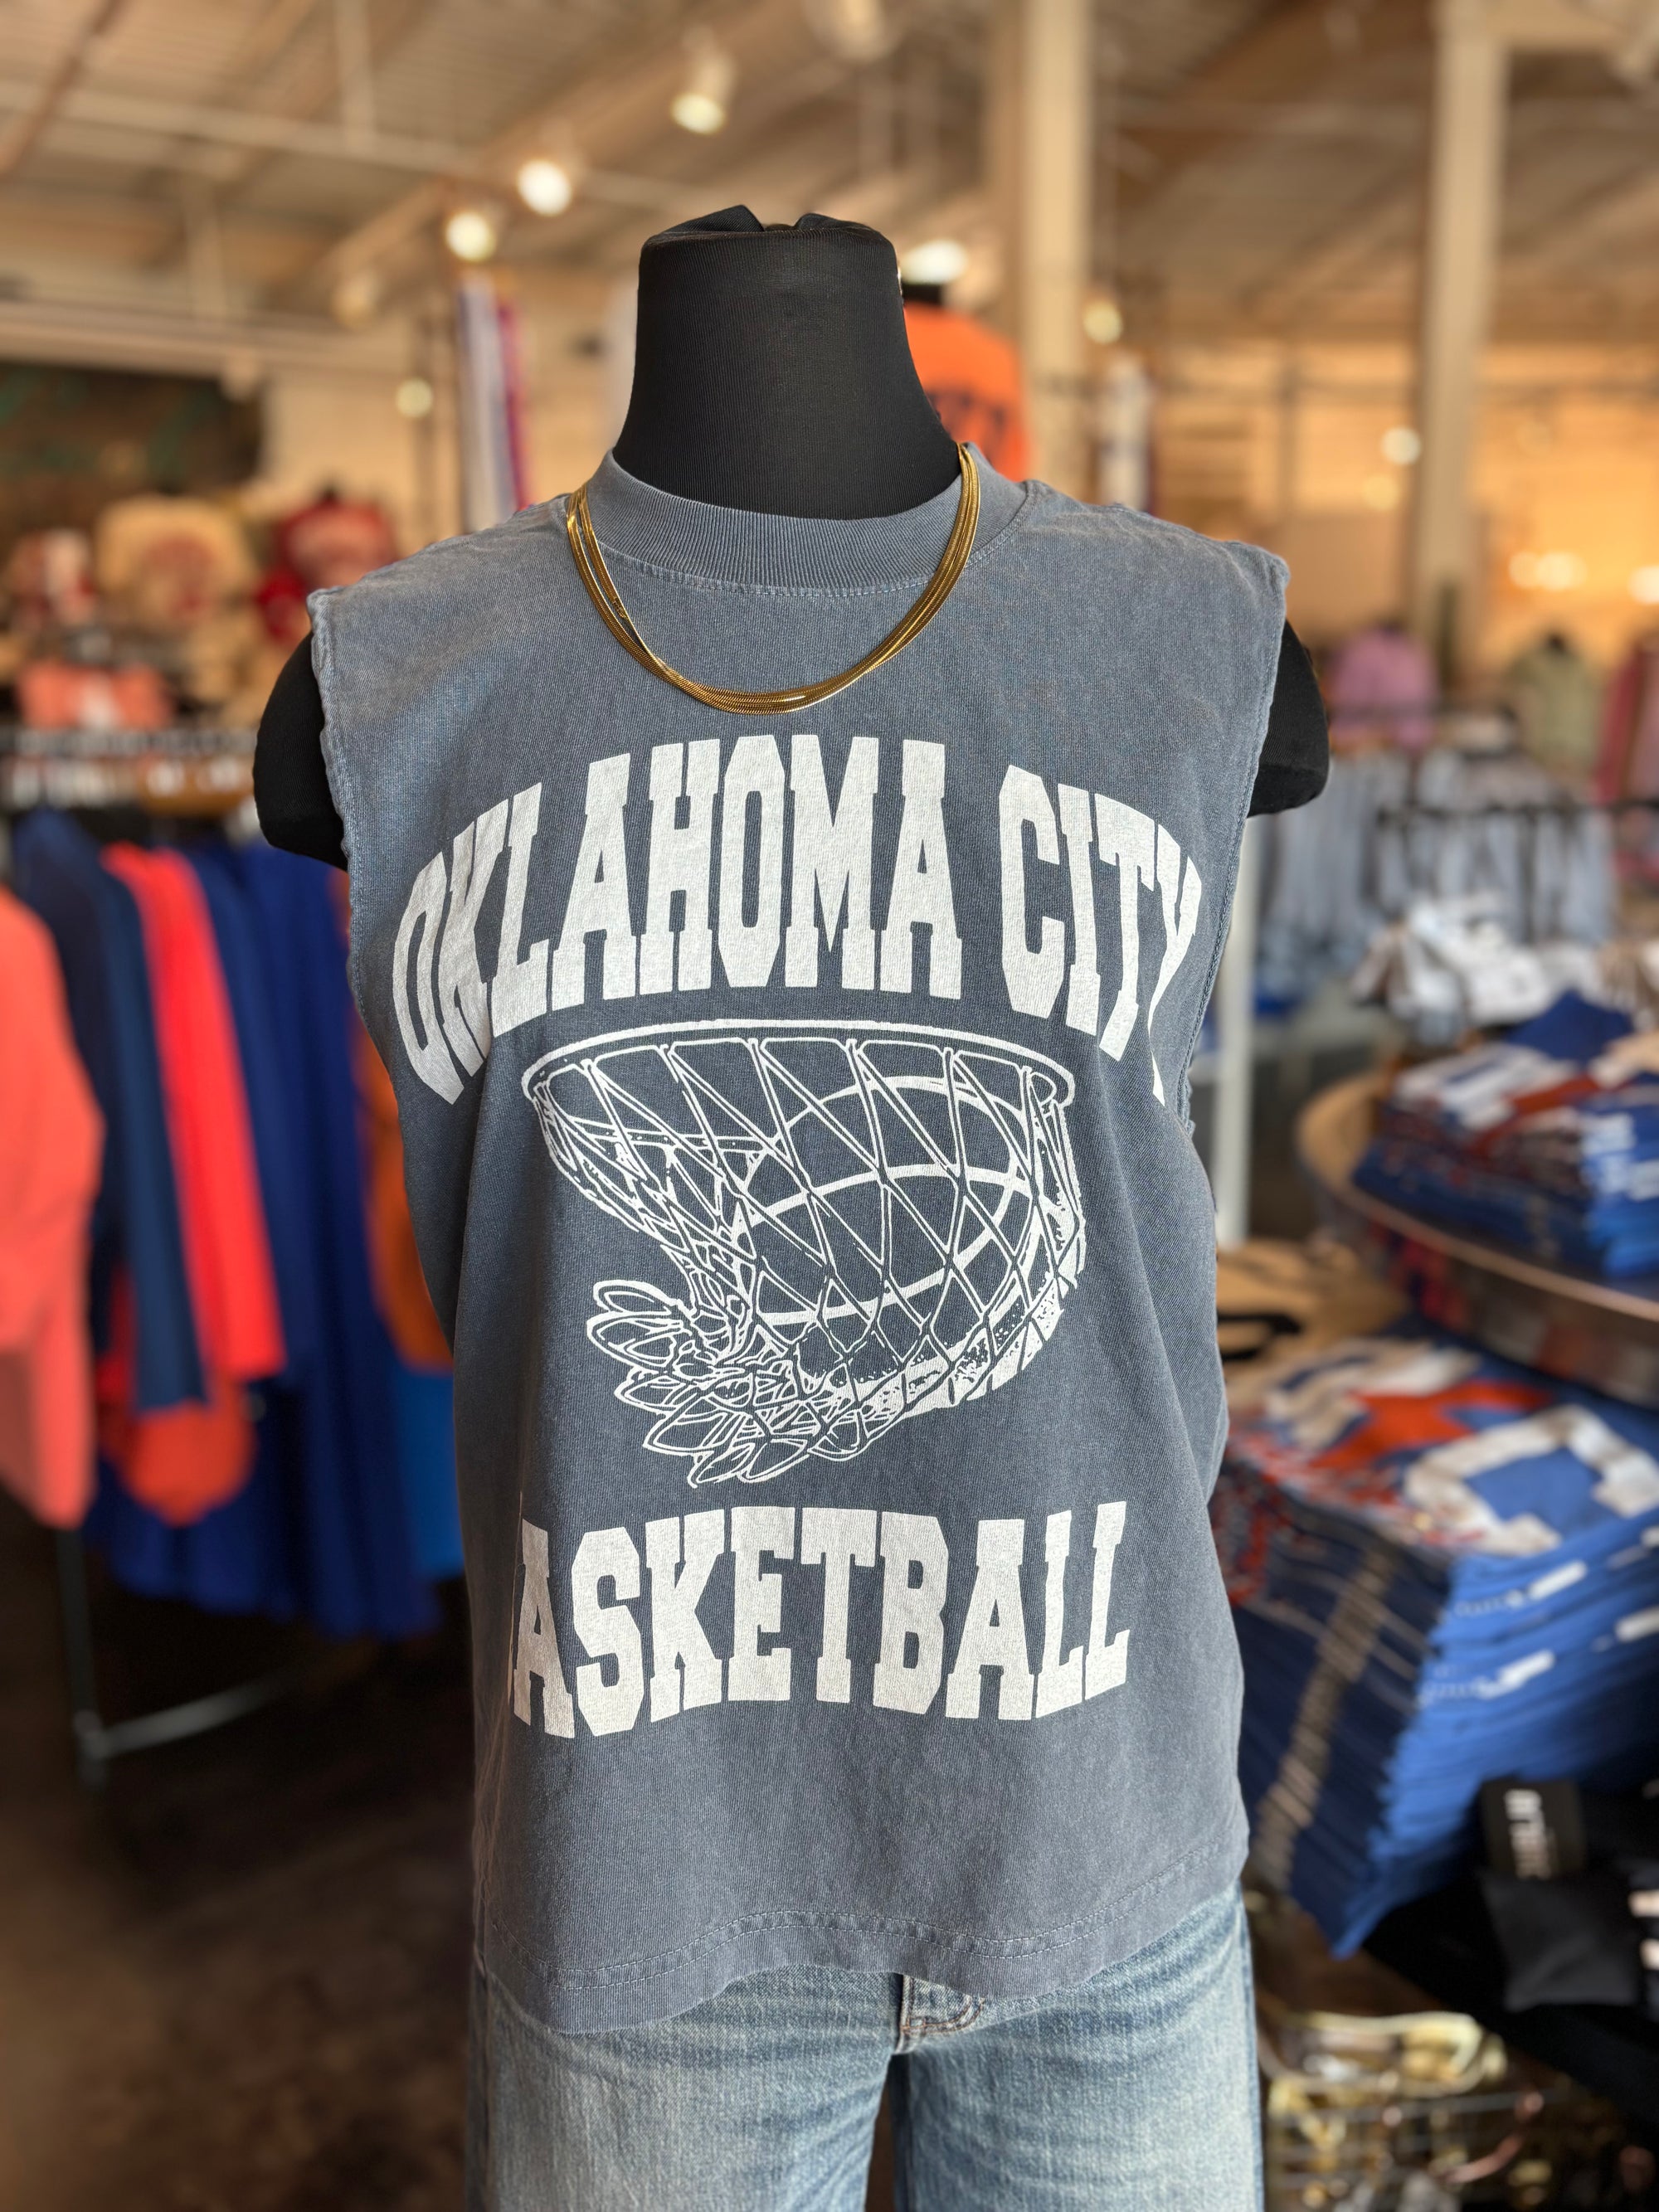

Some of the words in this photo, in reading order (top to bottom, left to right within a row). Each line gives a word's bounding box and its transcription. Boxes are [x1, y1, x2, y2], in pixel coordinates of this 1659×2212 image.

[392, 734, 961, 1105] OKLAHOMA
[998, 765, 1202, 1106] CITY
[508, 1500, 1131, 1738] ASKETBALL
